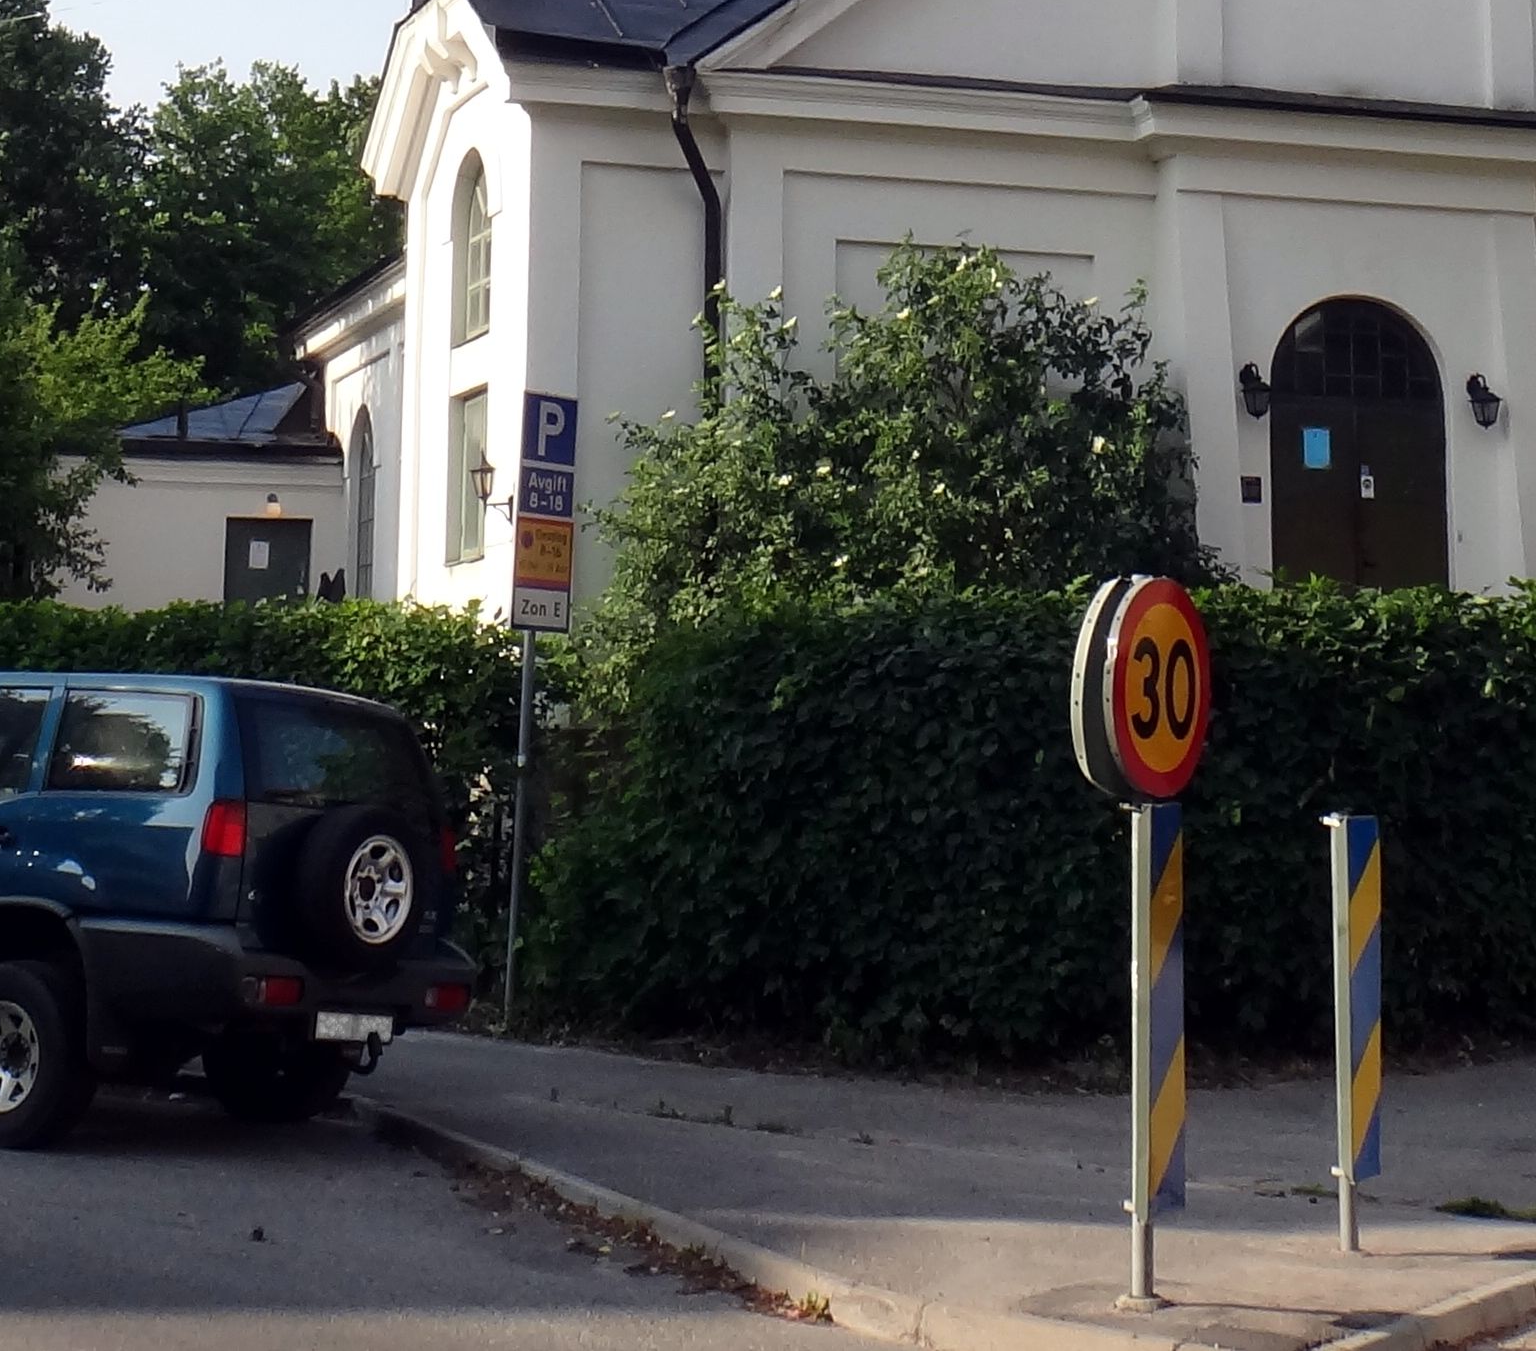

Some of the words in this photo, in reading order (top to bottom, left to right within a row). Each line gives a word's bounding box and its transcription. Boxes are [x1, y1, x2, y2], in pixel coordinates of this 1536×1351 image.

[537, 400, 565, 456] P
[528, 472, 566, 494] Avgift
[521, 598, 546, 617] Zon
[553, 602, 561, 618] E
[1131, 636, 1196, 740] 30
